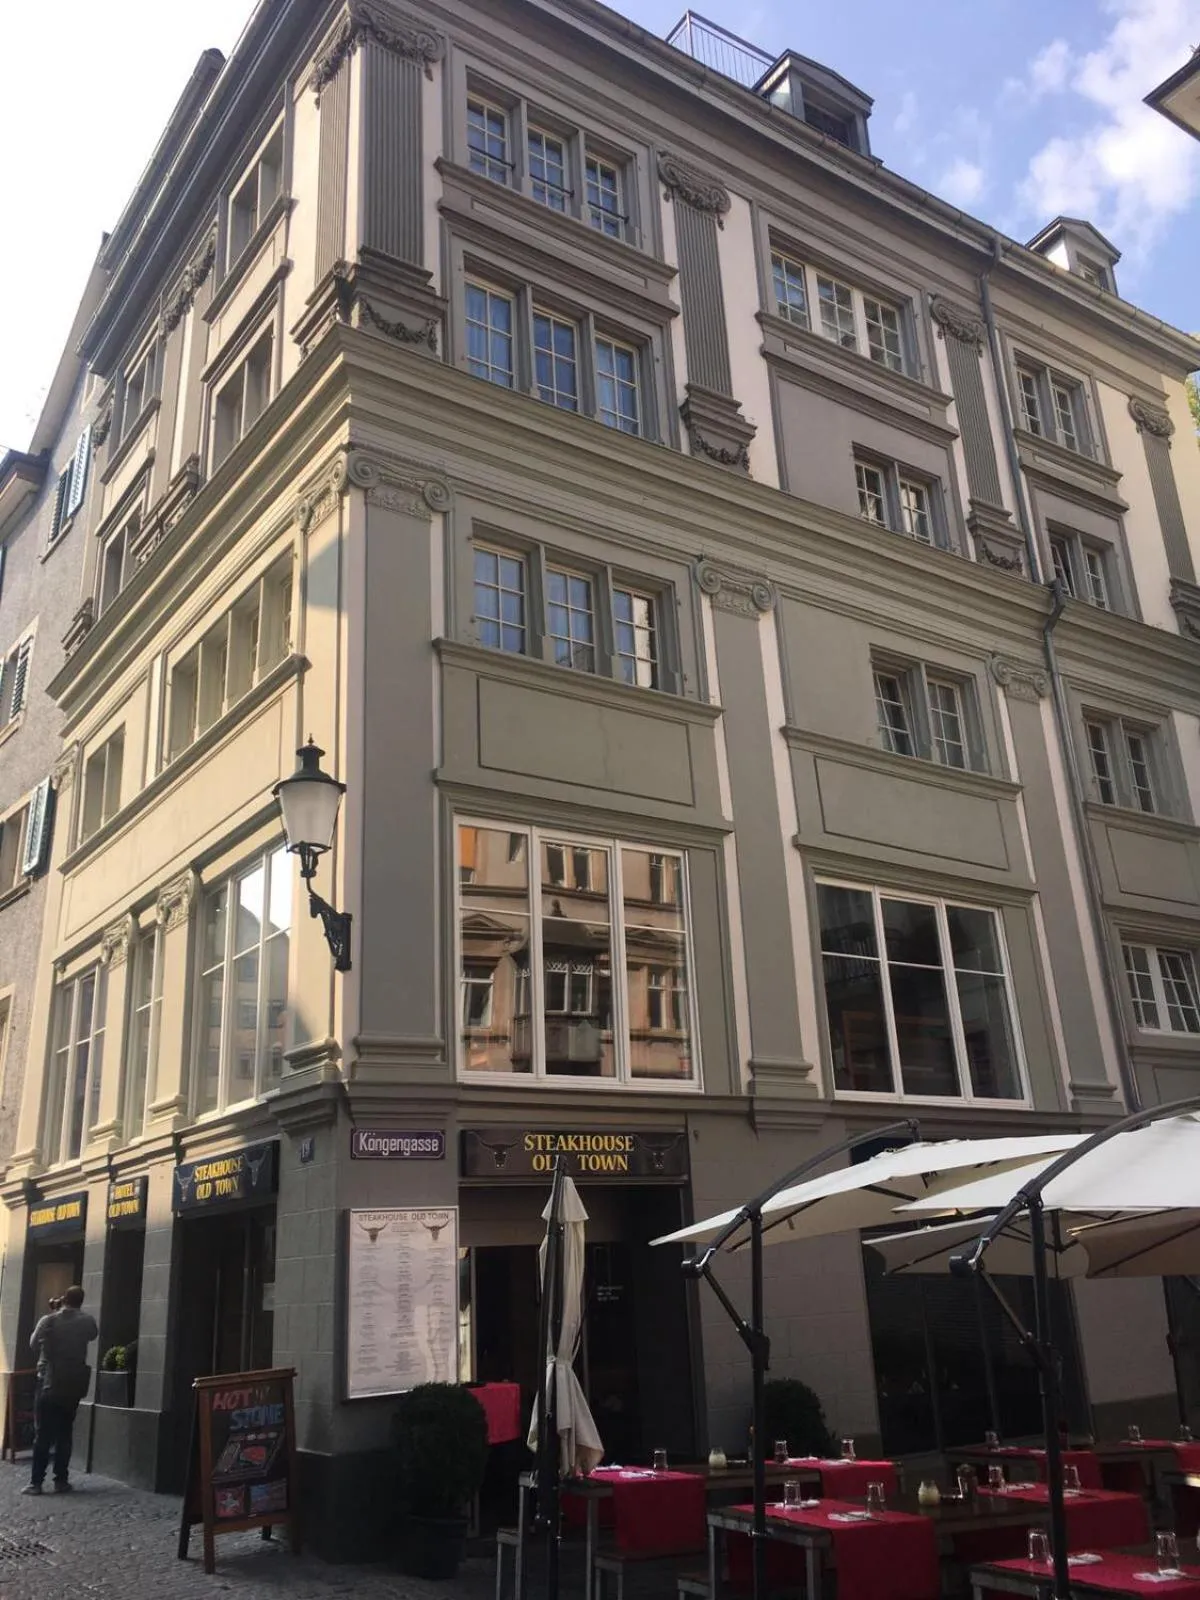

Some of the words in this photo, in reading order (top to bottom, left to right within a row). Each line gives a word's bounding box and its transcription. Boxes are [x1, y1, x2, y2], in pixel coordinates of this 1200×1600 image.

[524, 1134, 634, 1151] STEAKHOUSE
[195, 1156, 242, 1182] STEAKHOUSE
[532, 1154, 557, 1171] OL
[577, 1154, 629, 1171] TOWN
[196, 1182, 212, 1200] OLD
[215, 1176, 239, 1196] TOWN
[358, 1212, 408, 1221] STEAKHOUSE
[411, 1212, 426, 1221] OLD
[428, 1211, 449, 1220] TOWN
[213, 1387, 253, 1411] HOT
[230, 1403, 285, 1430] STONE
